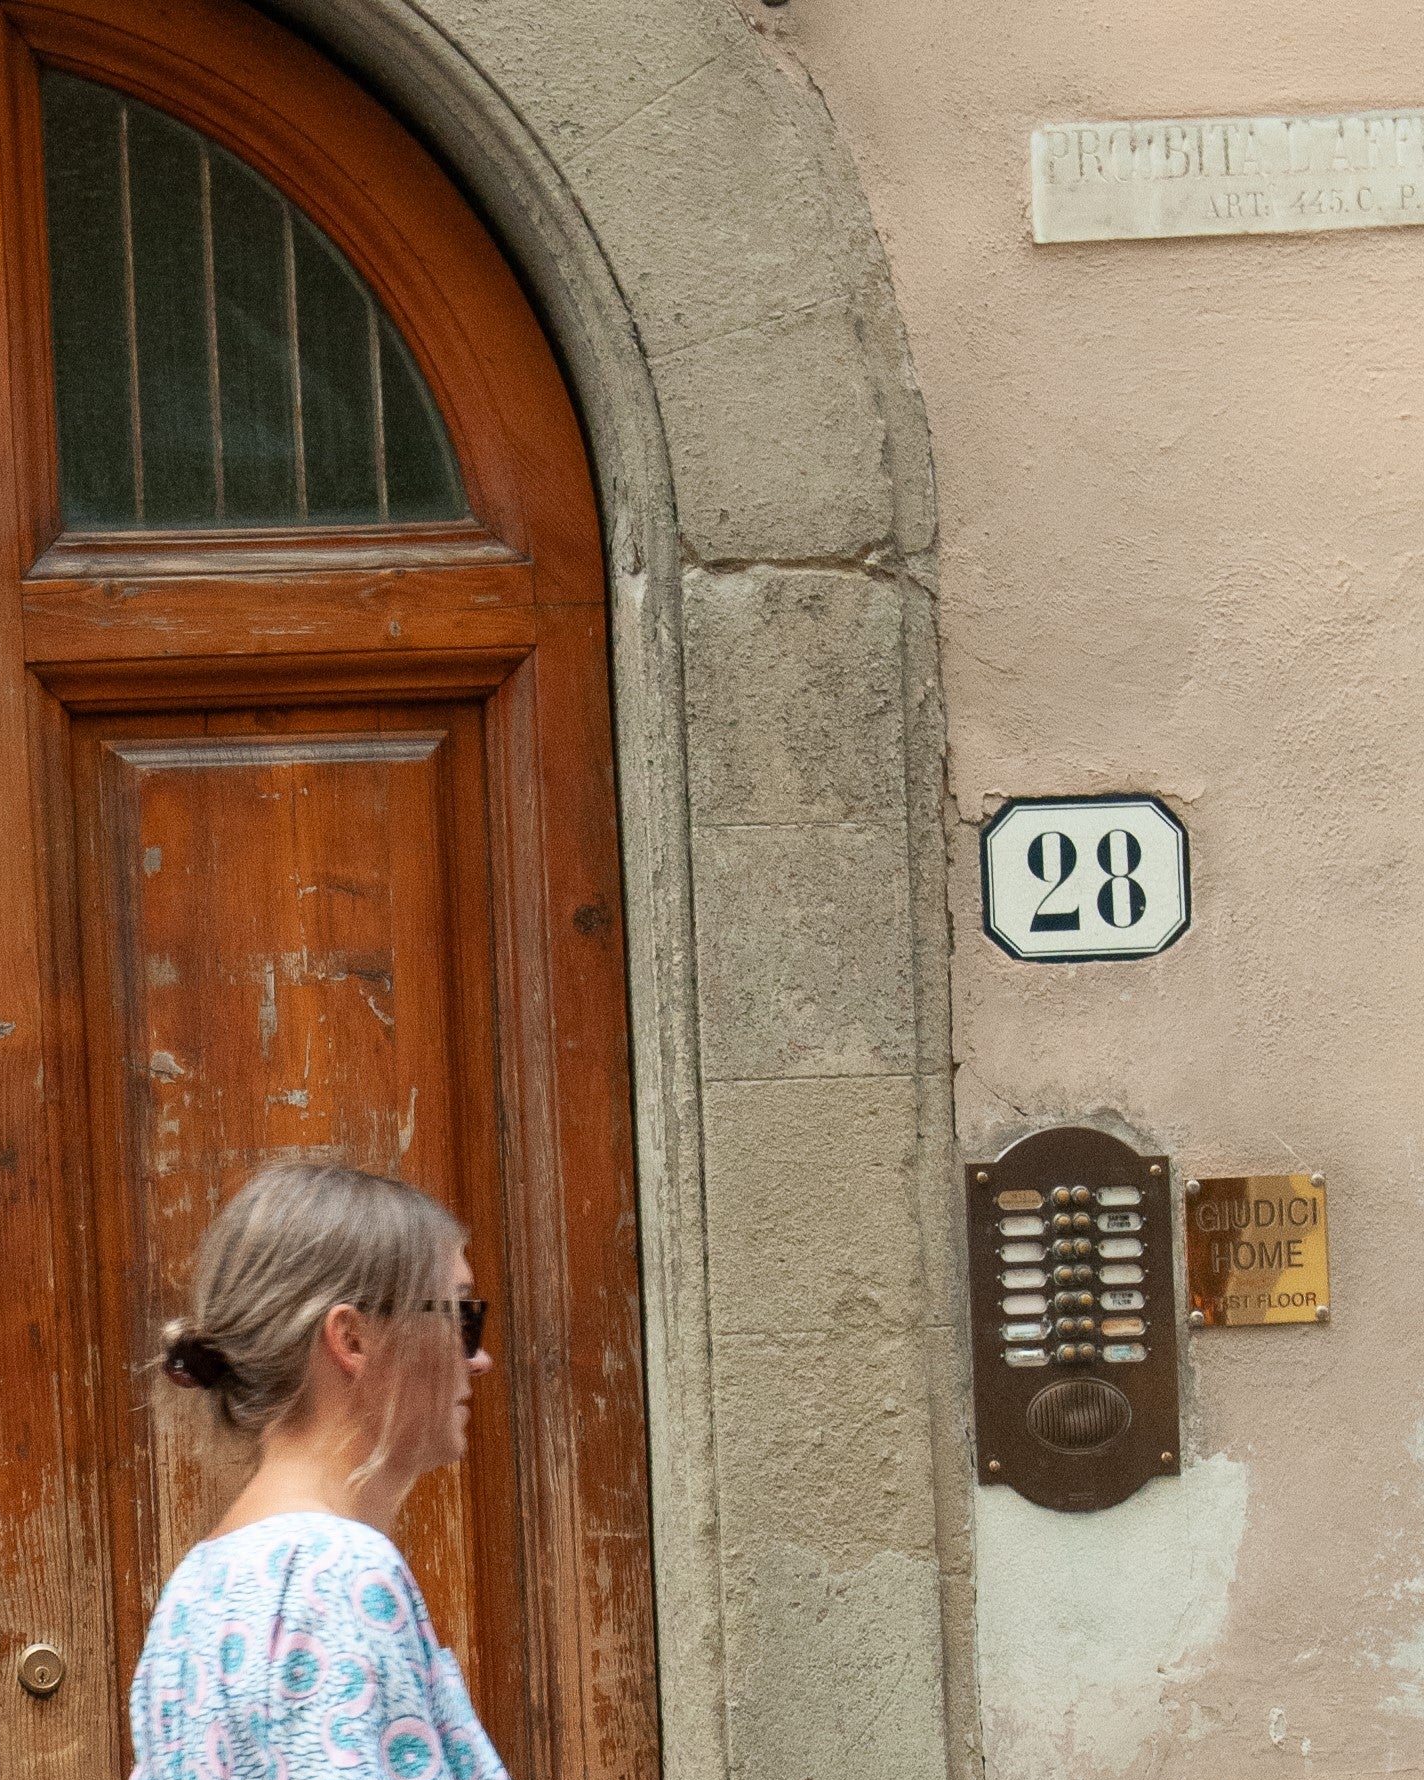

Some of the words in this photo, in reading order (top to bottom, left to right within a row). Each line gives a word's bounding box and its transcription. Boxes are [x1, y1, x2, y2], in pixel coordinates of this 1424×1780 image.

[1027, 829, 1147, 933] 28
[1196, 1197, 1318, 1232] GIUDICI
[1211, 1240, 1304, 1273] HOME
[1257, 1291, 1317, 1310] FLOOR
